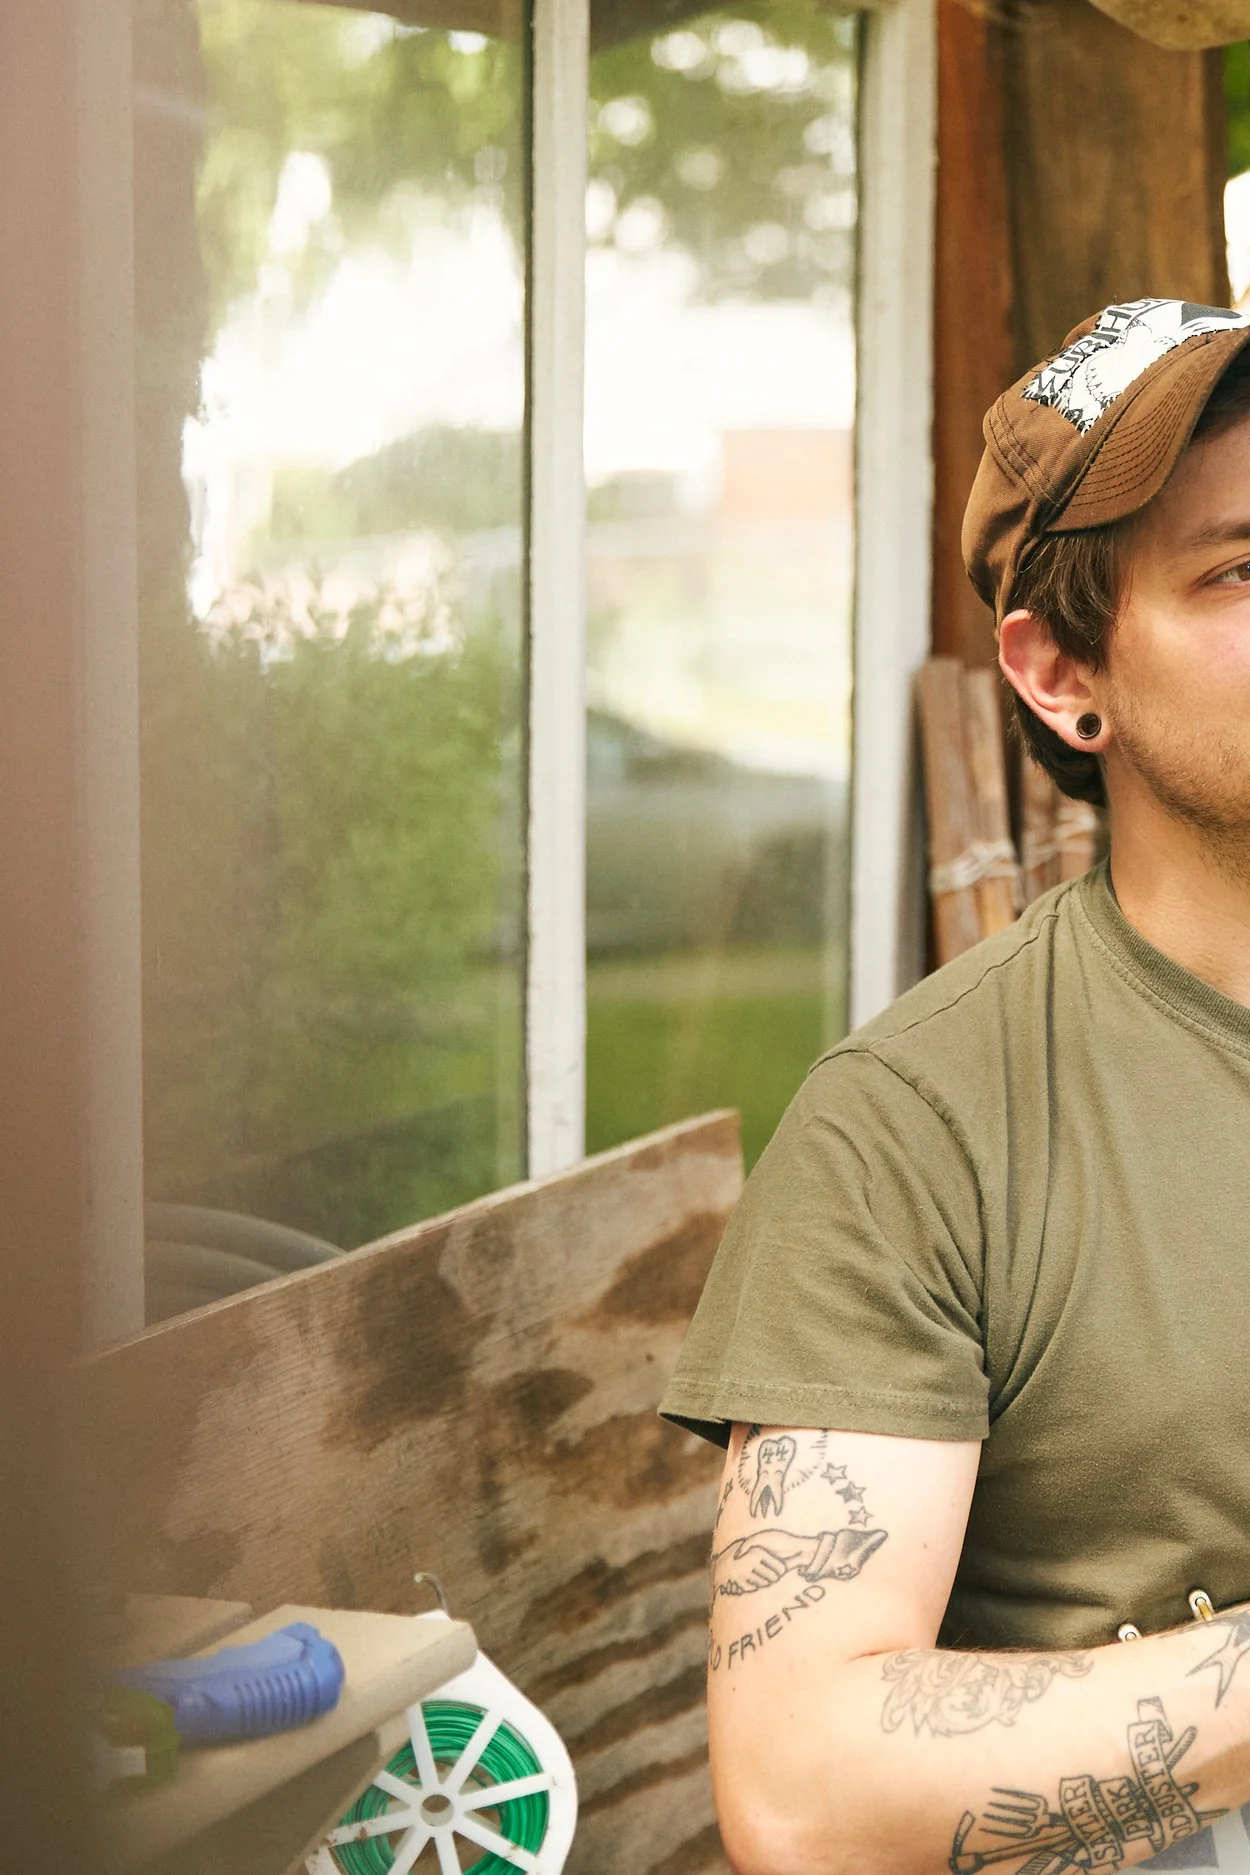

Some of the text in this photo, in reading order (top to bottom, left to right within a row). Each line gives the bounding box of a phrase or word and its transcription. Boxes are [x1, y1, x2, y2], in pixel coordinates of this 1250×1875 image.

[728, 1585, 825, 1670] FRIEND
[1063, 1781, 1118, 1861] SAYLER
[1107, 1783, 1155, 1837] PARK
[1134, 1725, 1193, 1841] ODBUSTER
